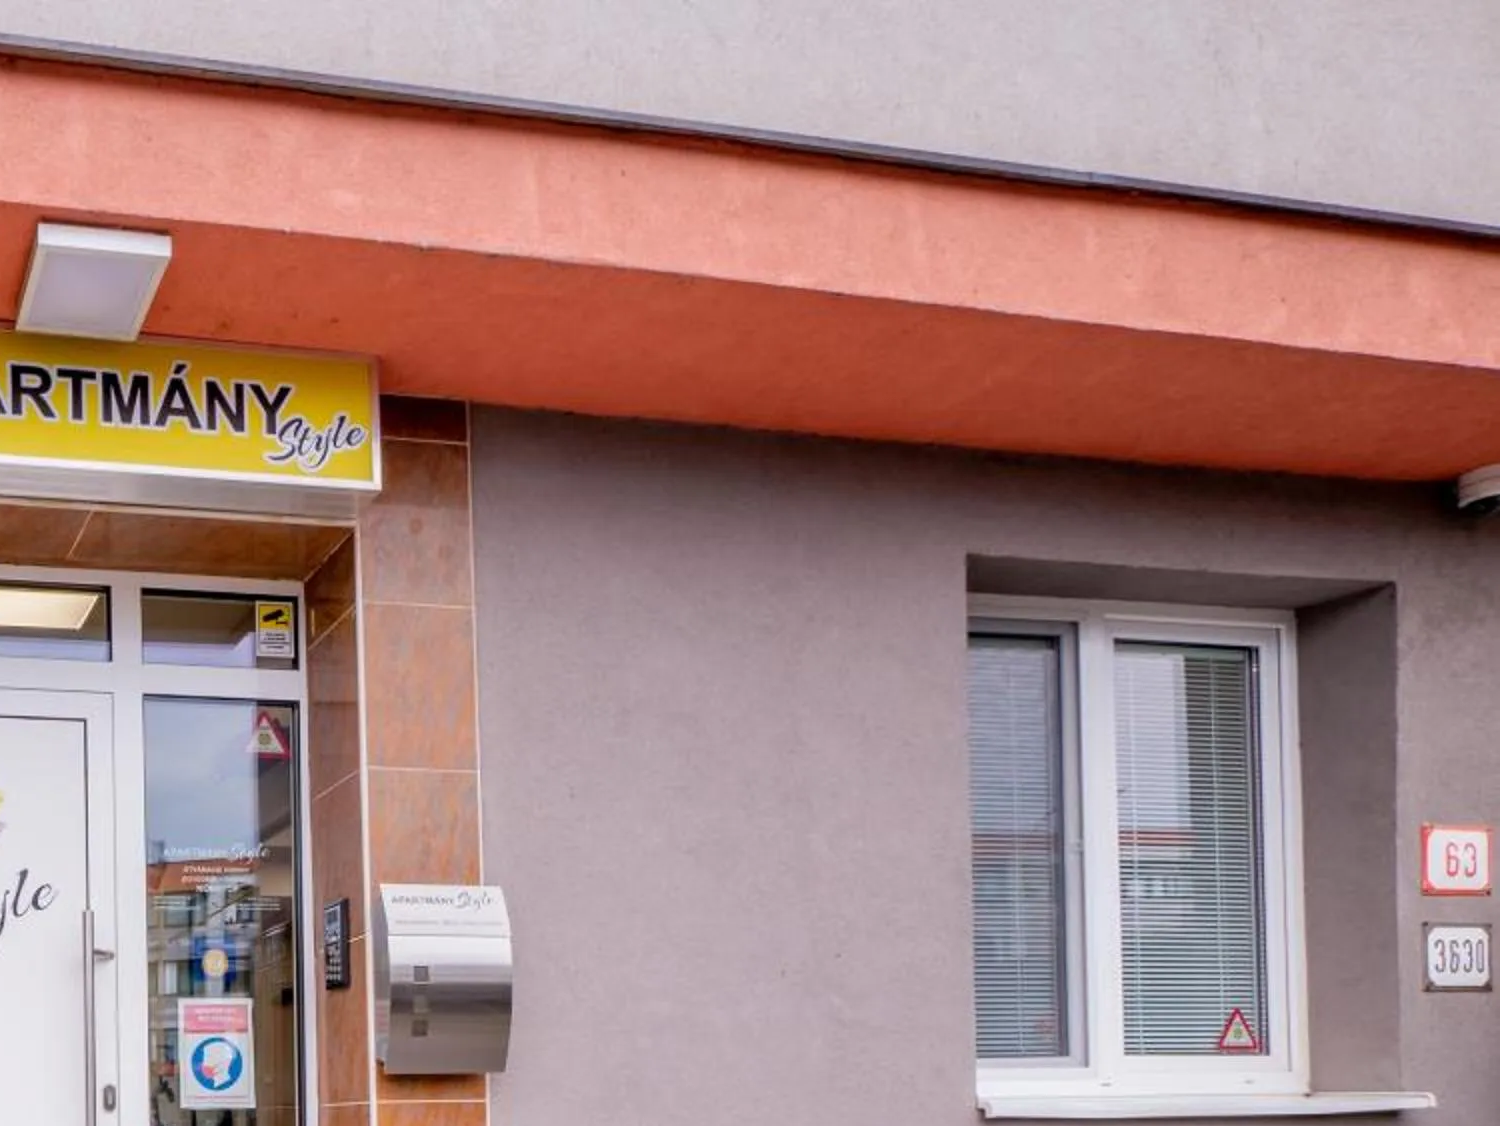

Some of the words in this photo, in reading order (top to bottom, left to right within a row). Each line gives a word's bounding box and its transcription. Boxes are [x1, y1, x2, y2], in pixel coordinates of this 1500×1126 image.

[267, 416, 366, 469] Style
[1445, 842, 1477, 877] 63
[1434, 938, 1485, 974] 3630
